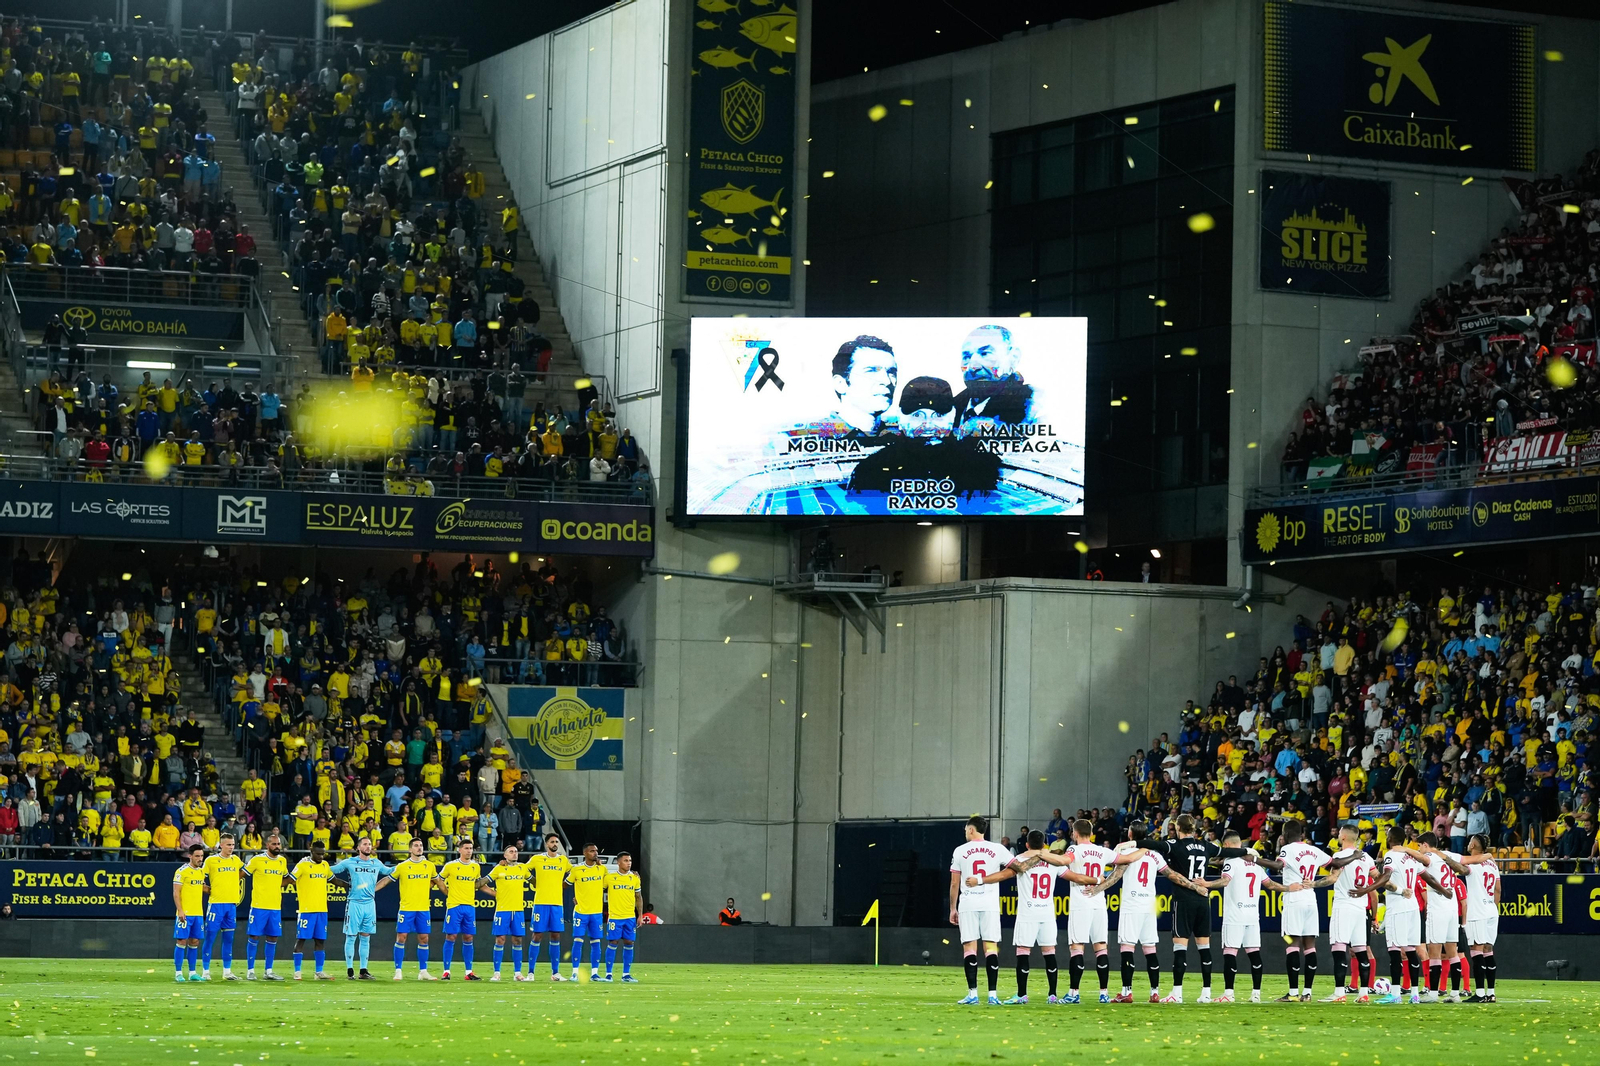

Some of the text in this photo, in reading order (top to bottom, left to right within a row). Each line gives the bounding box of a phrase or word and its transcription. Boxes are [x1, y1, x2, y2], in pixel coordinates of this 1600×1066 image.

[1343, 115, 1458, 150] CaixaBank
[700, 148, 783, 165] PETACA CHICO
[1281, 227, 1368, 265] SLICE
[699, 255, 779, 270] petacachico.com
[1281, 257, 1368, 274] NEW YORK PIZZA
[101, 308, 132, 317] TOYOTA
[100, 319, 187, 335] GAMO BAHÍA
[981, 424, 1057, 438] MANUEL
[788, 438, 861, 454] MOLINA
[977, 440, 1062, 454] ARTEAGA
[888, 495, 958, 510] RAMOS
[1492, 498, 1553, 514] Díaz Cadenas
[1568, 494, 1597, 505] ESTUDIO
[0, 501, 53, 519] ADIZ
[71, 502, 170, 518] LAS CORTES
[306, 503, 413, 529] ESPALUZ
[1323, 502, 1387, 534] RESET
[1411, 503, 1470, 520] SohoBoutique
[1513, 512, 1531, 522] CASH
[562, 518, 652, 542] coanda
[1283, 515, 1306, 546] bp
[1427, 520, 1453, 531] HOTELS
[1337, 536, 1351, 546] ART
[1352, 535, 1362, 544] OF
[1364, 532, 1386, 543] BODY
[529, 709, 604, 745] Mahareta
[963, 847, 996, 860] L.OCAMPOS
[973, 860, 986, 881] 5
[1138, 862, 1149, 887] 4
[1188, 855, 1207, 880] 13
[12, 869, 156, 888] PETACA CHICO
[1355, 866, 1366, 887] 6
[1483, 872, 1495, 897] 12
[1030, 873, 1051, 899] 19
[1246, 873, 1257, 898] 7
[12, 892, 154, 906] FISH & SEAFOOD EXPORT
